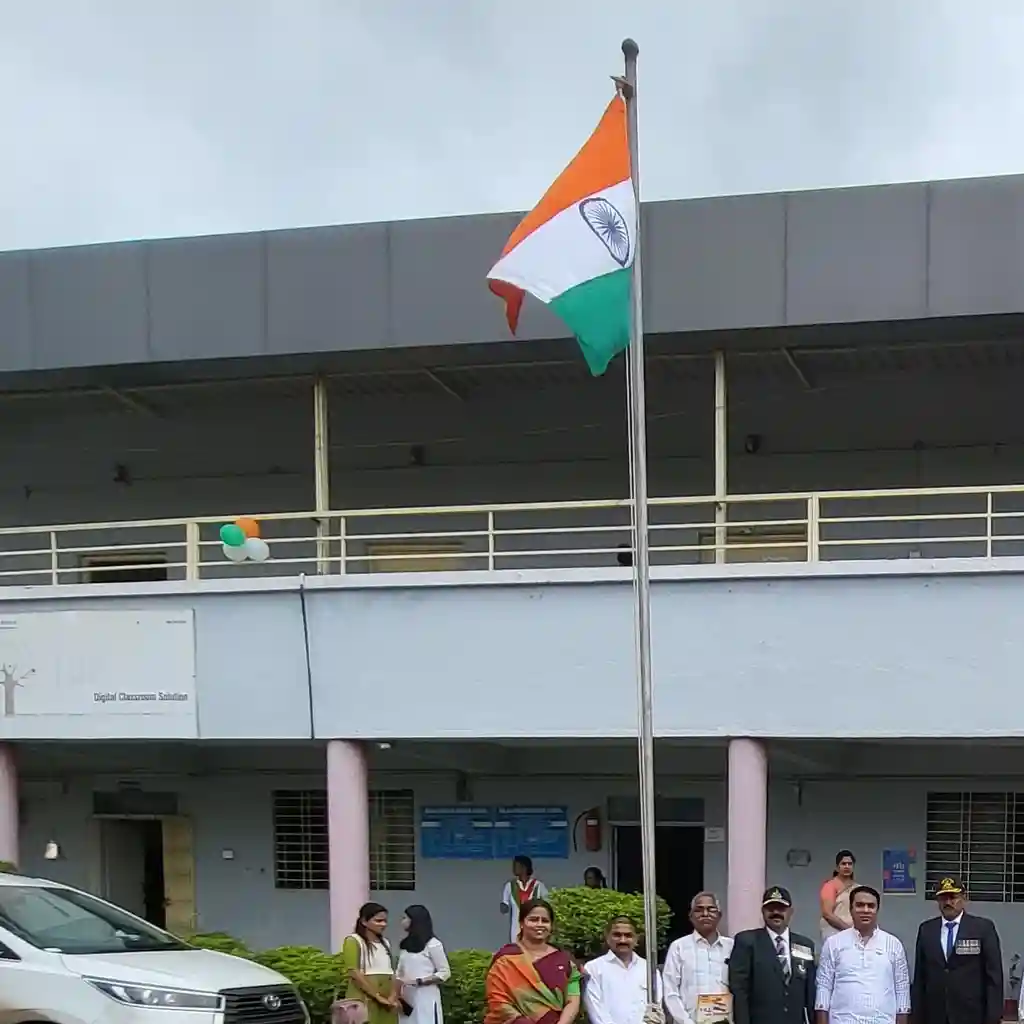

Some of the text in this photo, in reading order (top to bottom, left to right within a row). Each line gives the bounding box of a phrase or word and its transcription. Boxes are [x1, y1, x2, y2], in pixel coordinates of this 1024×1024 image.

[93, 691, 188, 703] Digital Classroom Solution
